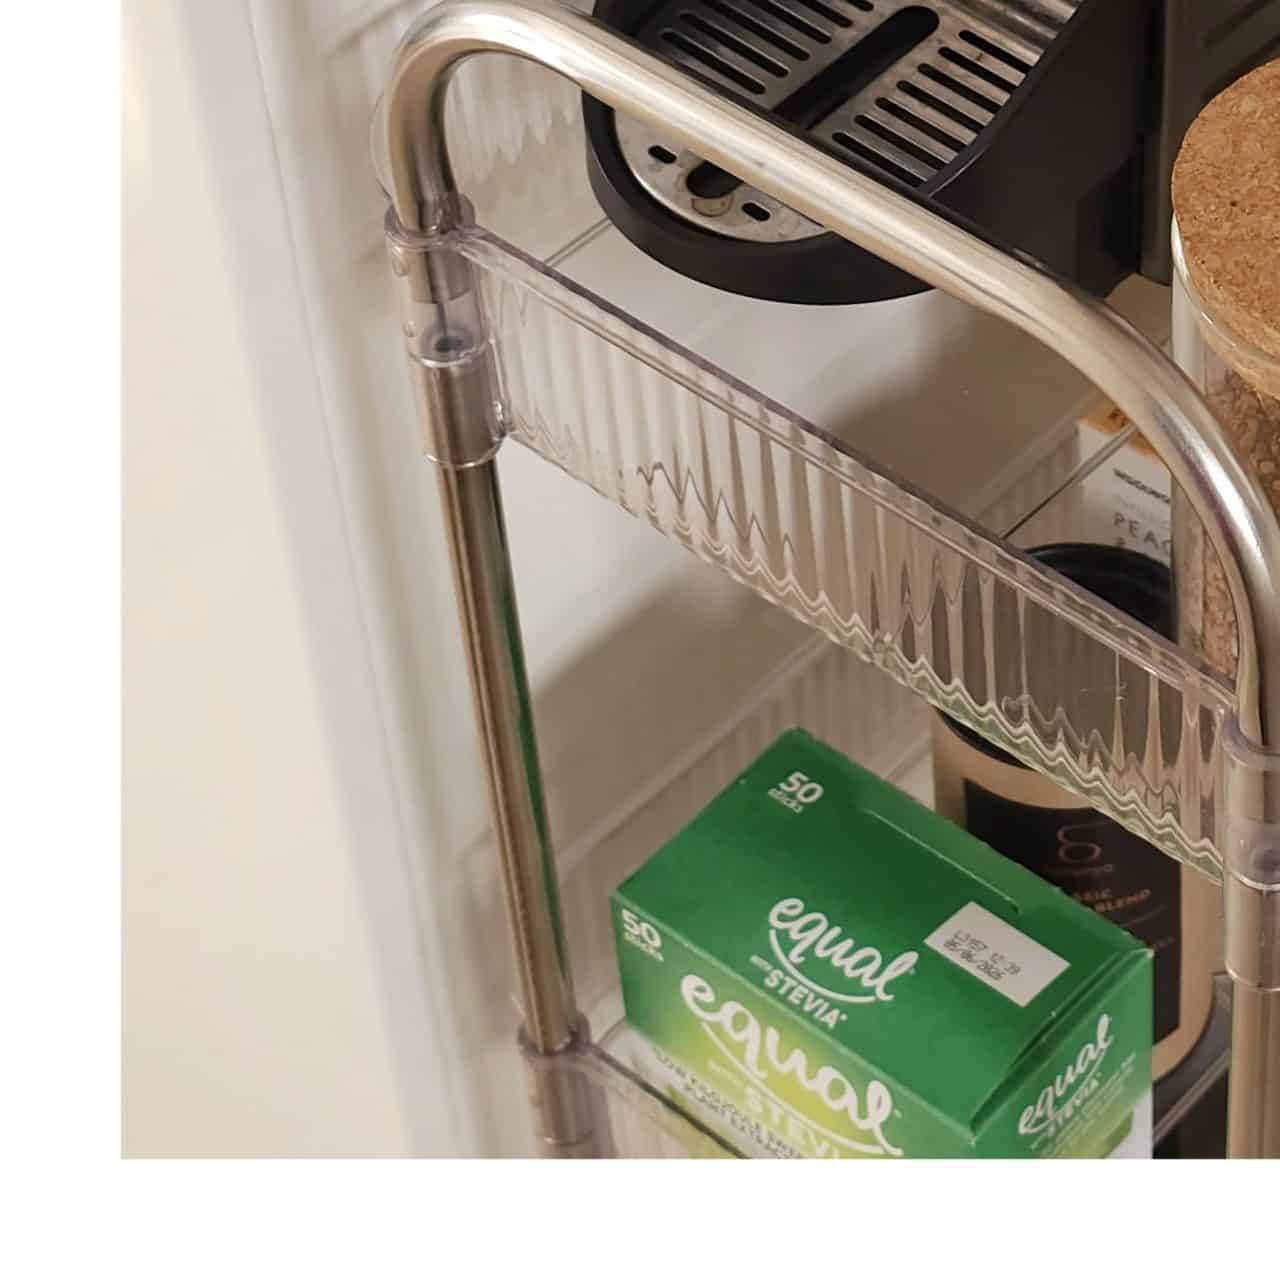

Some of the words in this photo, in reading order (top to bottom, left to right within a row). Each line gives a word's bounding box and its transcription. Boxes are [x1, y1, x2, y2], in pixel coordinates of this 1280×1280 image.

[1113, 511, 1171, 556] PEAC
[779, 771, 824, 803] 50
[622, 908, 662, 948] 50
[768, 897, 919, 1001] equal
[764, 969, 836, 1029] STEVIA
[680, 974, 904, 1156] equal
[1018, 1013, 1115, 1136] equal
